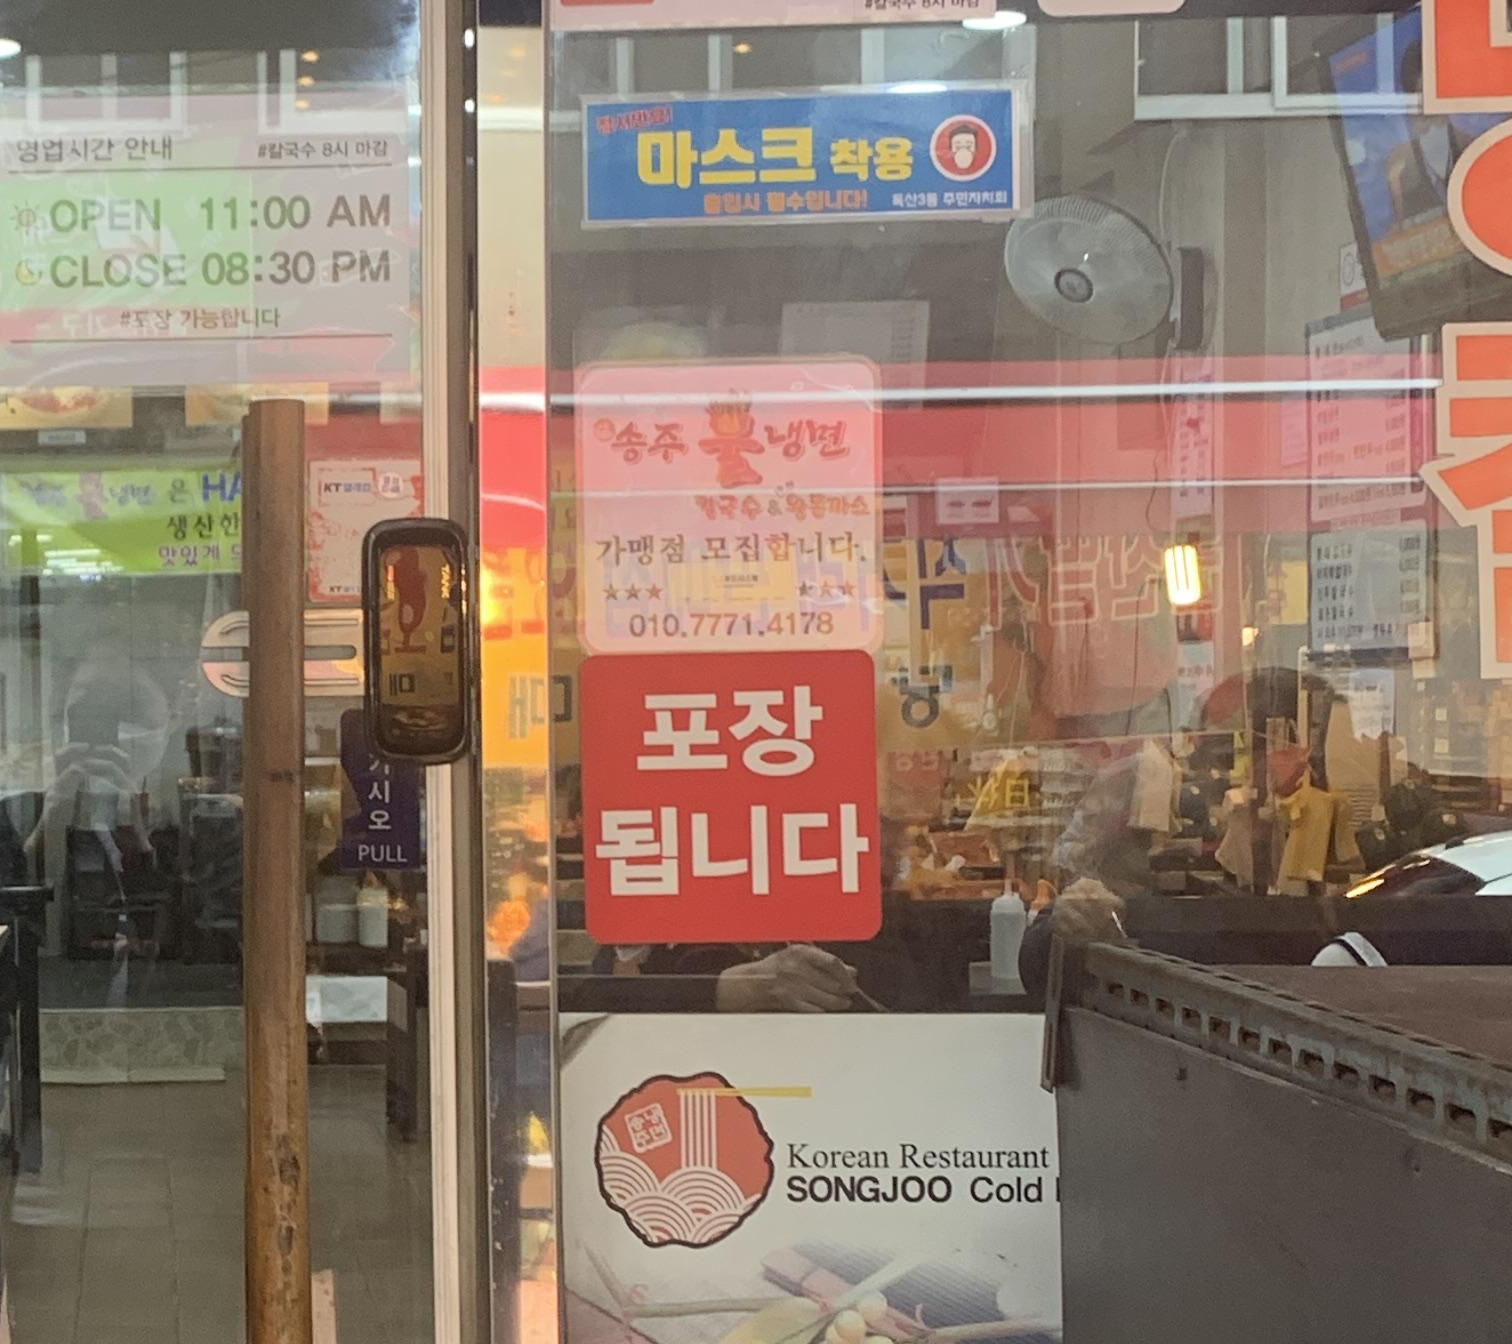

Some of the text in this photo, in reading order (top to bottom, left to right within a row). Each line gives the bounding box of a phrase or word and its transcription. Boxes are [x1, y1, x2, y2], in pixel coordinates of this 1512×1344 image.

[636, 127, 914, 189] 마스크 착용
[49, 193, 391, 233] OPEN 11:00 AM
[49, 249, 391, 288] CLOSE 08:30 PM
[596, 534, 685, 567] 가맹점
[628, 611, 835, 638] 010.7771.4178
[637, 684, 823, 776] 포장
[358, 844, 408, 863] PULL
[595, 802, 869, 895] 됩니다
[787, 1143, 1050, 1169] Korean Restaurant
[786, 1175, 953, 1204] SONGJOO
[969, 1175, 1044, 1204] Cold
